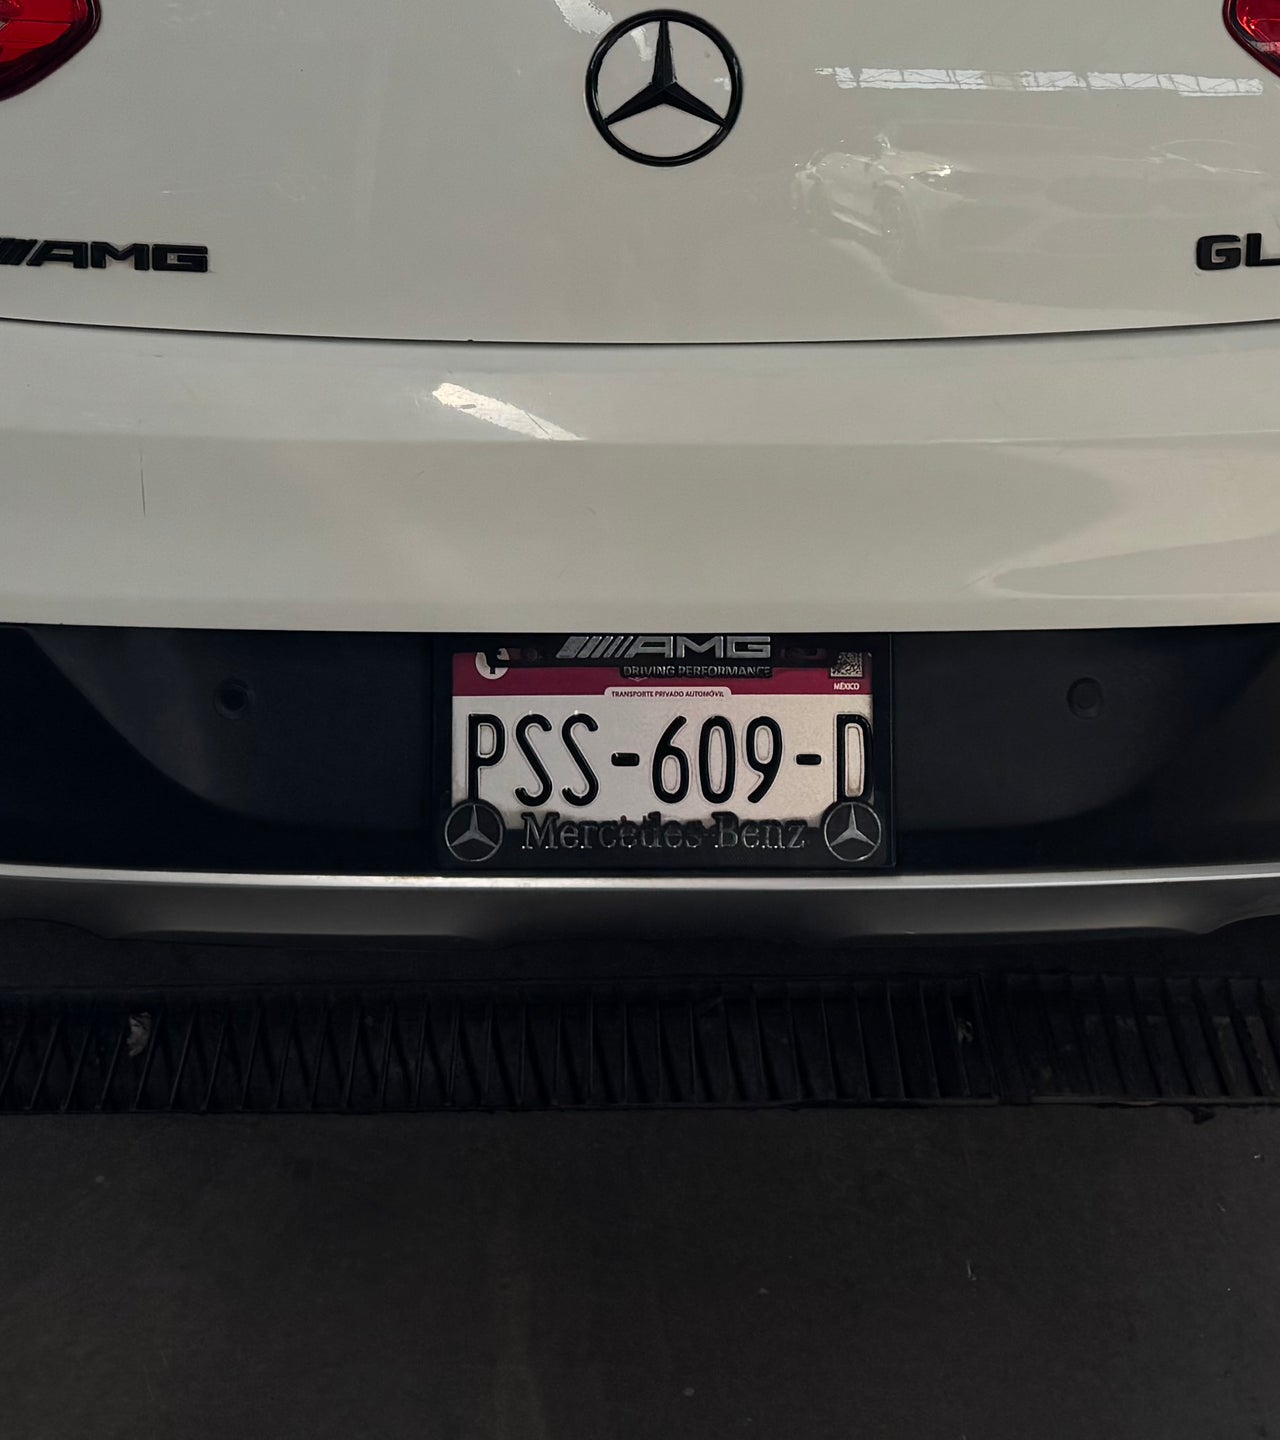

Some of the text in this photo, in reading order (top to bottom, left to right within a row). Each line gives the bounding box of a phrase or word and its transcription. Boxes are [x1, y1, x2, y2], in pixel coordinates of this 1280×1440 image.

[26, 241, 209, 272] AMG
[623, 635, 771, 659] AMG
[623, 665, 771, 677] DRIVING PERFORMANCE
[611, 689, 725, 698] TRANSPORTE PRIVADO AUTOMÓVIL
[833, 681, 860, 691] MÉXICO
[467, 712, 873, 807] PSS-609-D
